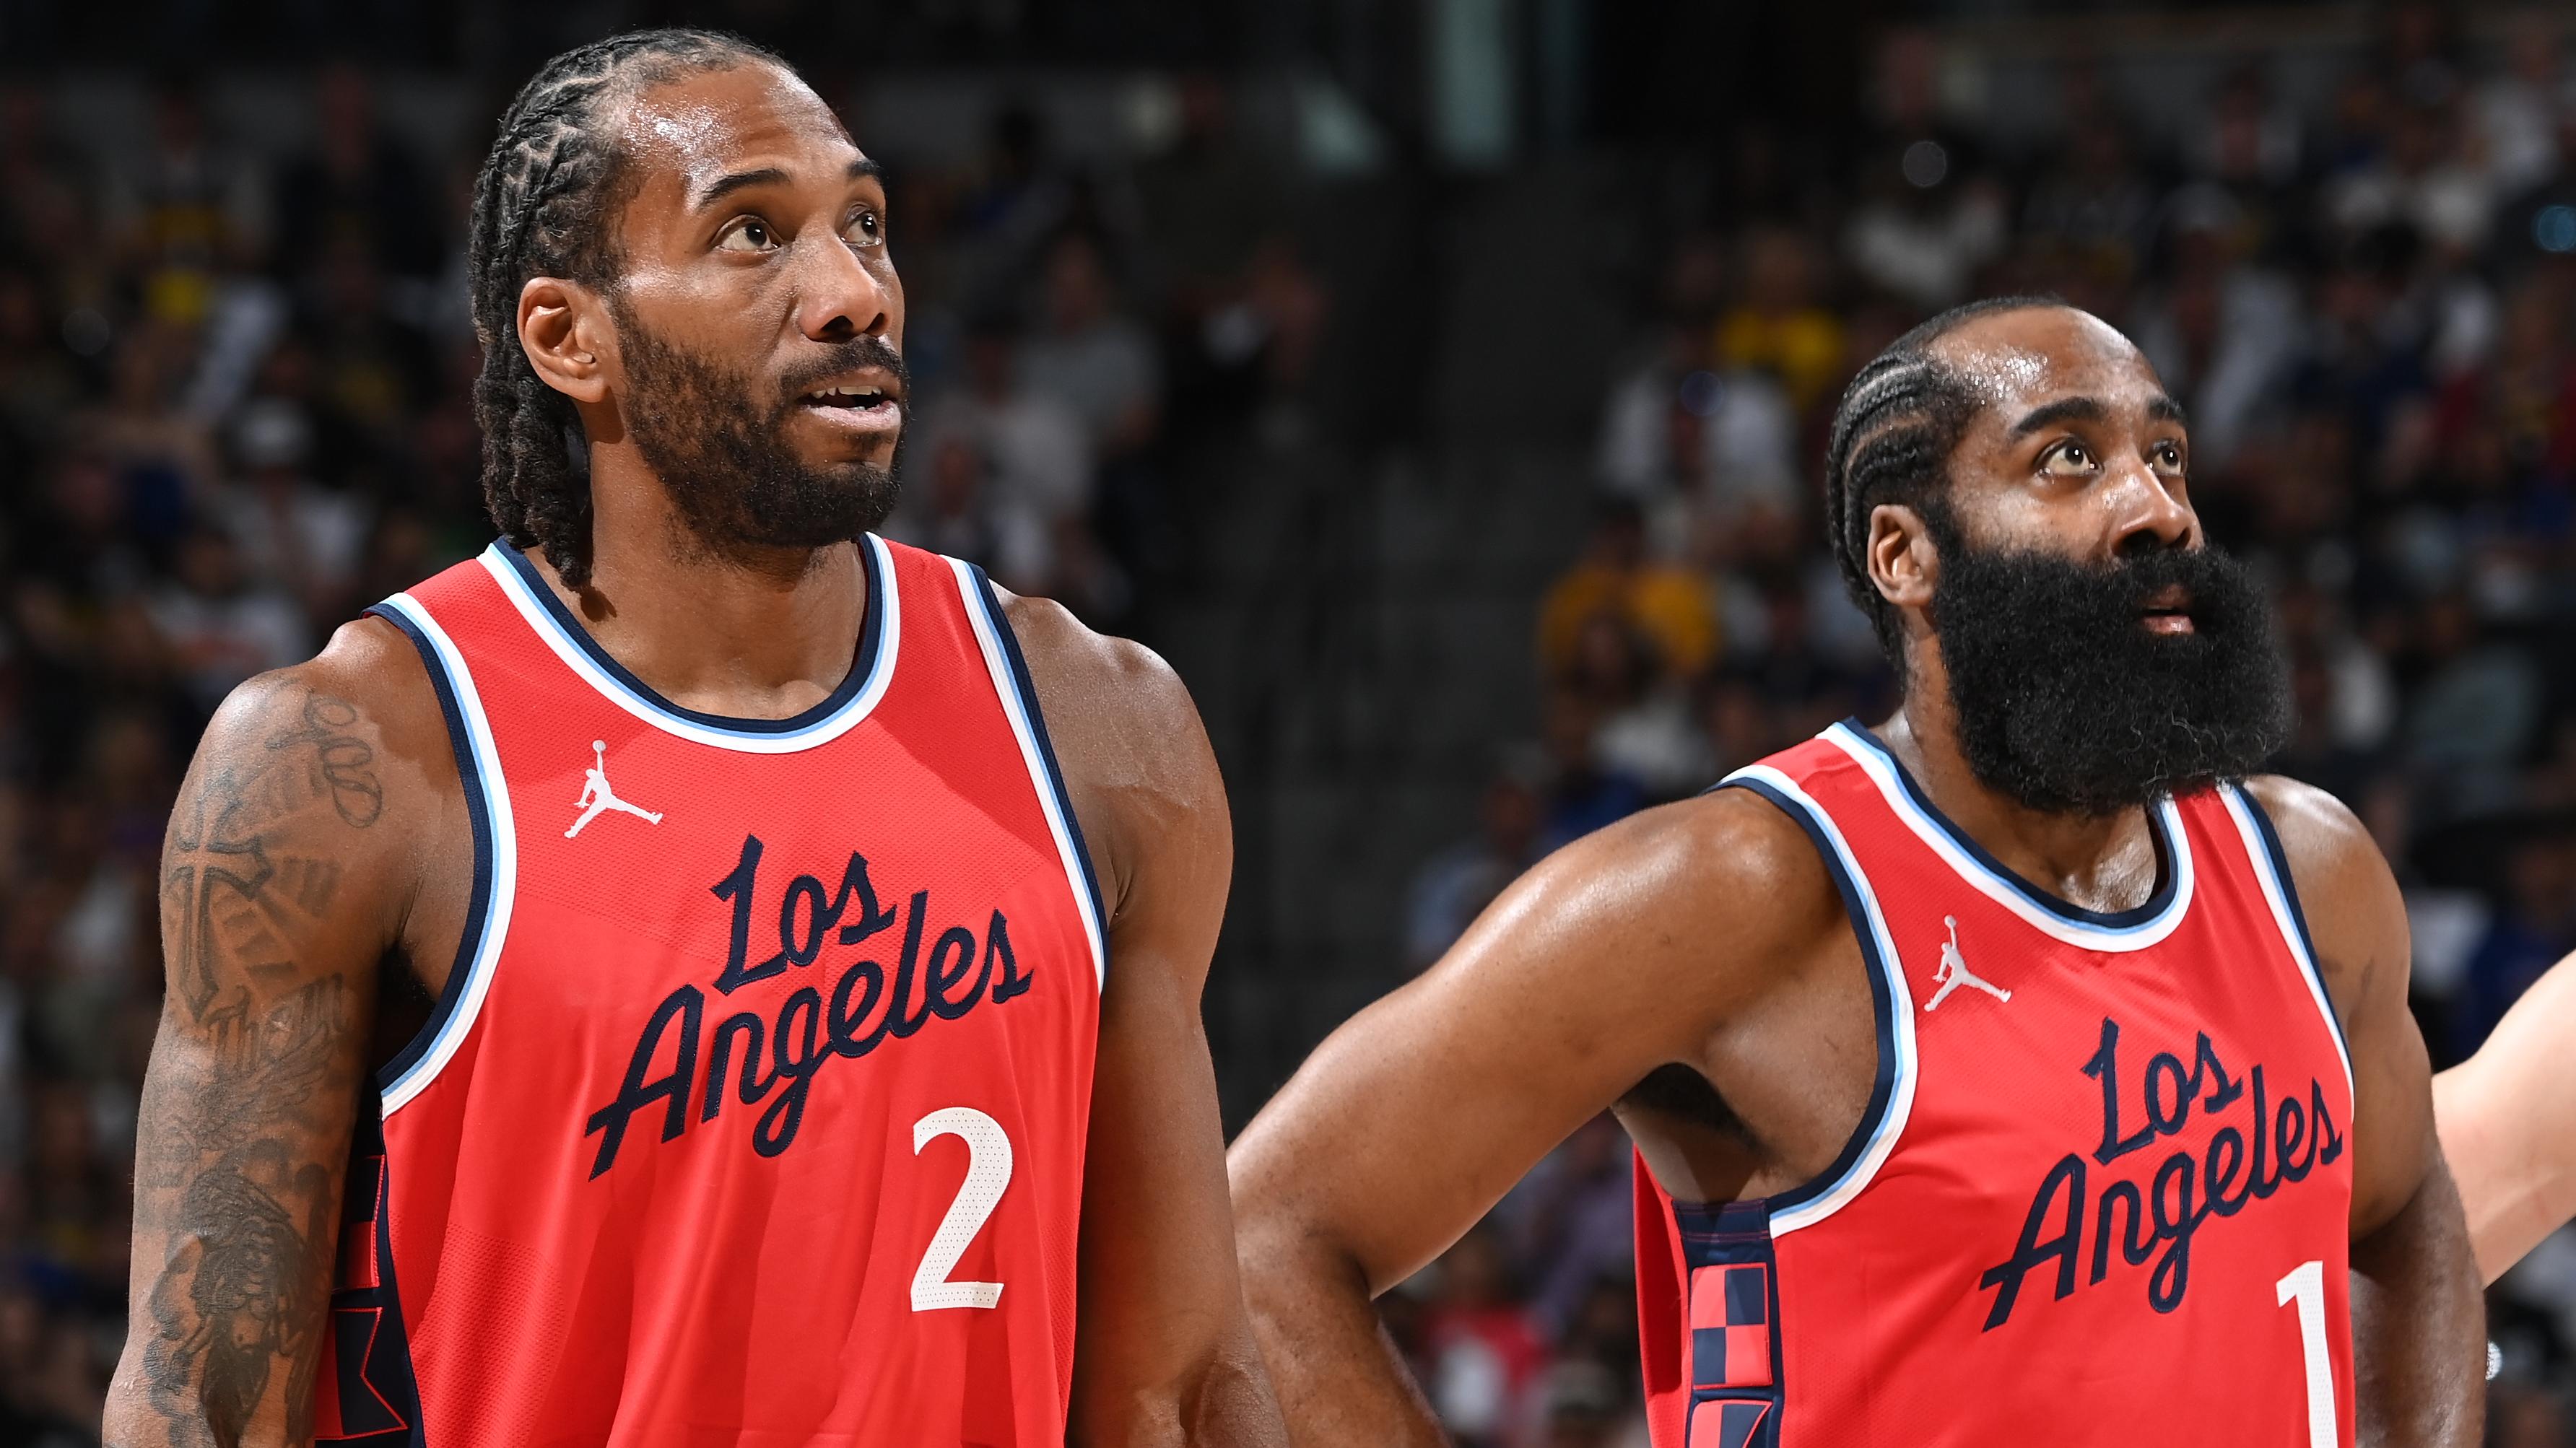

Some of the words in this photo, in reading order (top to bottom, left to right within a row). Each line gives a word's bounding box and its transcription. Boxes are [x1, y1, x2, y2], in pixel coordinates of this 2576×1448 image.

[710, 834, 897, 995] Los
[585, 890, 1034, 1181] Angeles
[2081, 1016, 2242, 1166] Los
[910, 1107, 1013, 1312] 2
[1979, 1064, 2343, 1333] Angeles
[2276, 1260, 2339, 1448] 1
